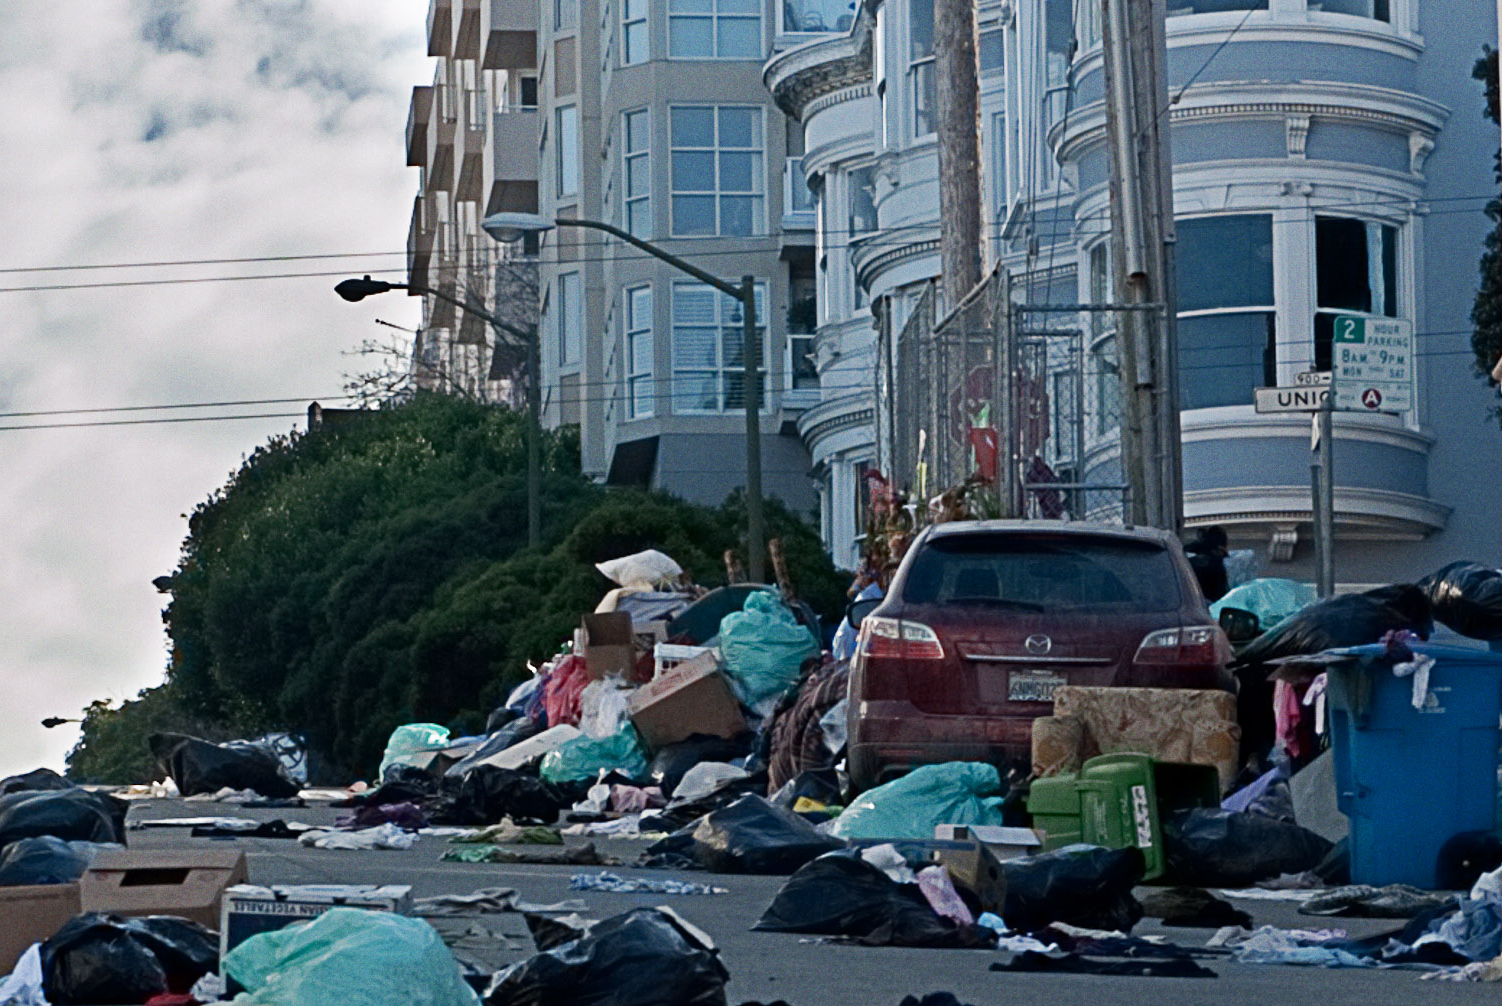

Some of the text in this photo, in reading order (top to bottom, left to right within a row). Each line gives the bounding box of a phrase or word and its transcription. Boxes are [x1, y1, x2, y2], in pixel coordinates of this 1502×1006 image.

[1343, 319, 1355, 339] 2
[1374, 324, 1400, 335] HOUR
[1367, 336, 1409, 348] PARKING
[1343, 367, 1362, 377] MON
[1389, 367, 1405, 378] SAT
[1364, 389, 1379, 405] A
[233, 901, 296, 912] VEGETABLES
